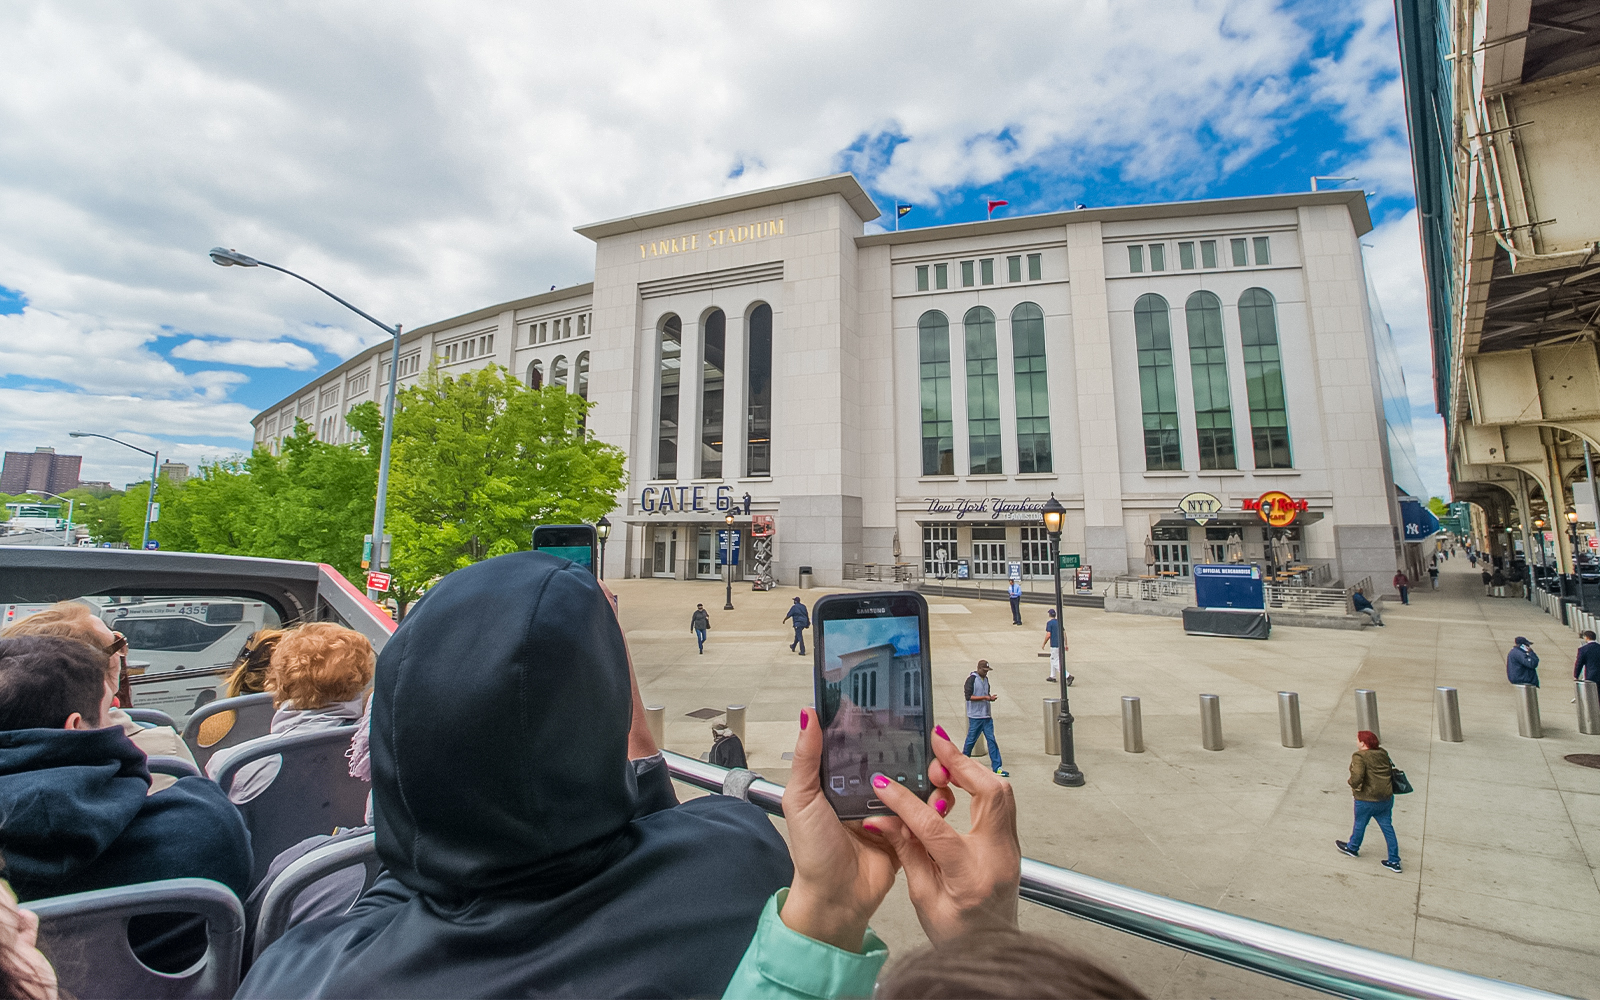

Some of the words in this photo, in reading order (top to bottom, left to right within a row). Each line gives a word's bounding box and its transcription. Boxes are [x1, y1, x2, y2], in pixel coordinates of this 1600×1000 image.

[640, 233, 699, 259] YANKEE
[708, 218, 785, 248] STADIUM
[641, 486, 706, 513] GATE
[716, 485, 732, 512] 6
[1188, 500, 1214, 511] NYY
[1242, 497, 1276, 511] Had
[1277, 497, 1309, 513] Rock
[924, 498, 954, 512] New
[956, 498, 989, 520] York
[178, 606, 207, 615] 4355
